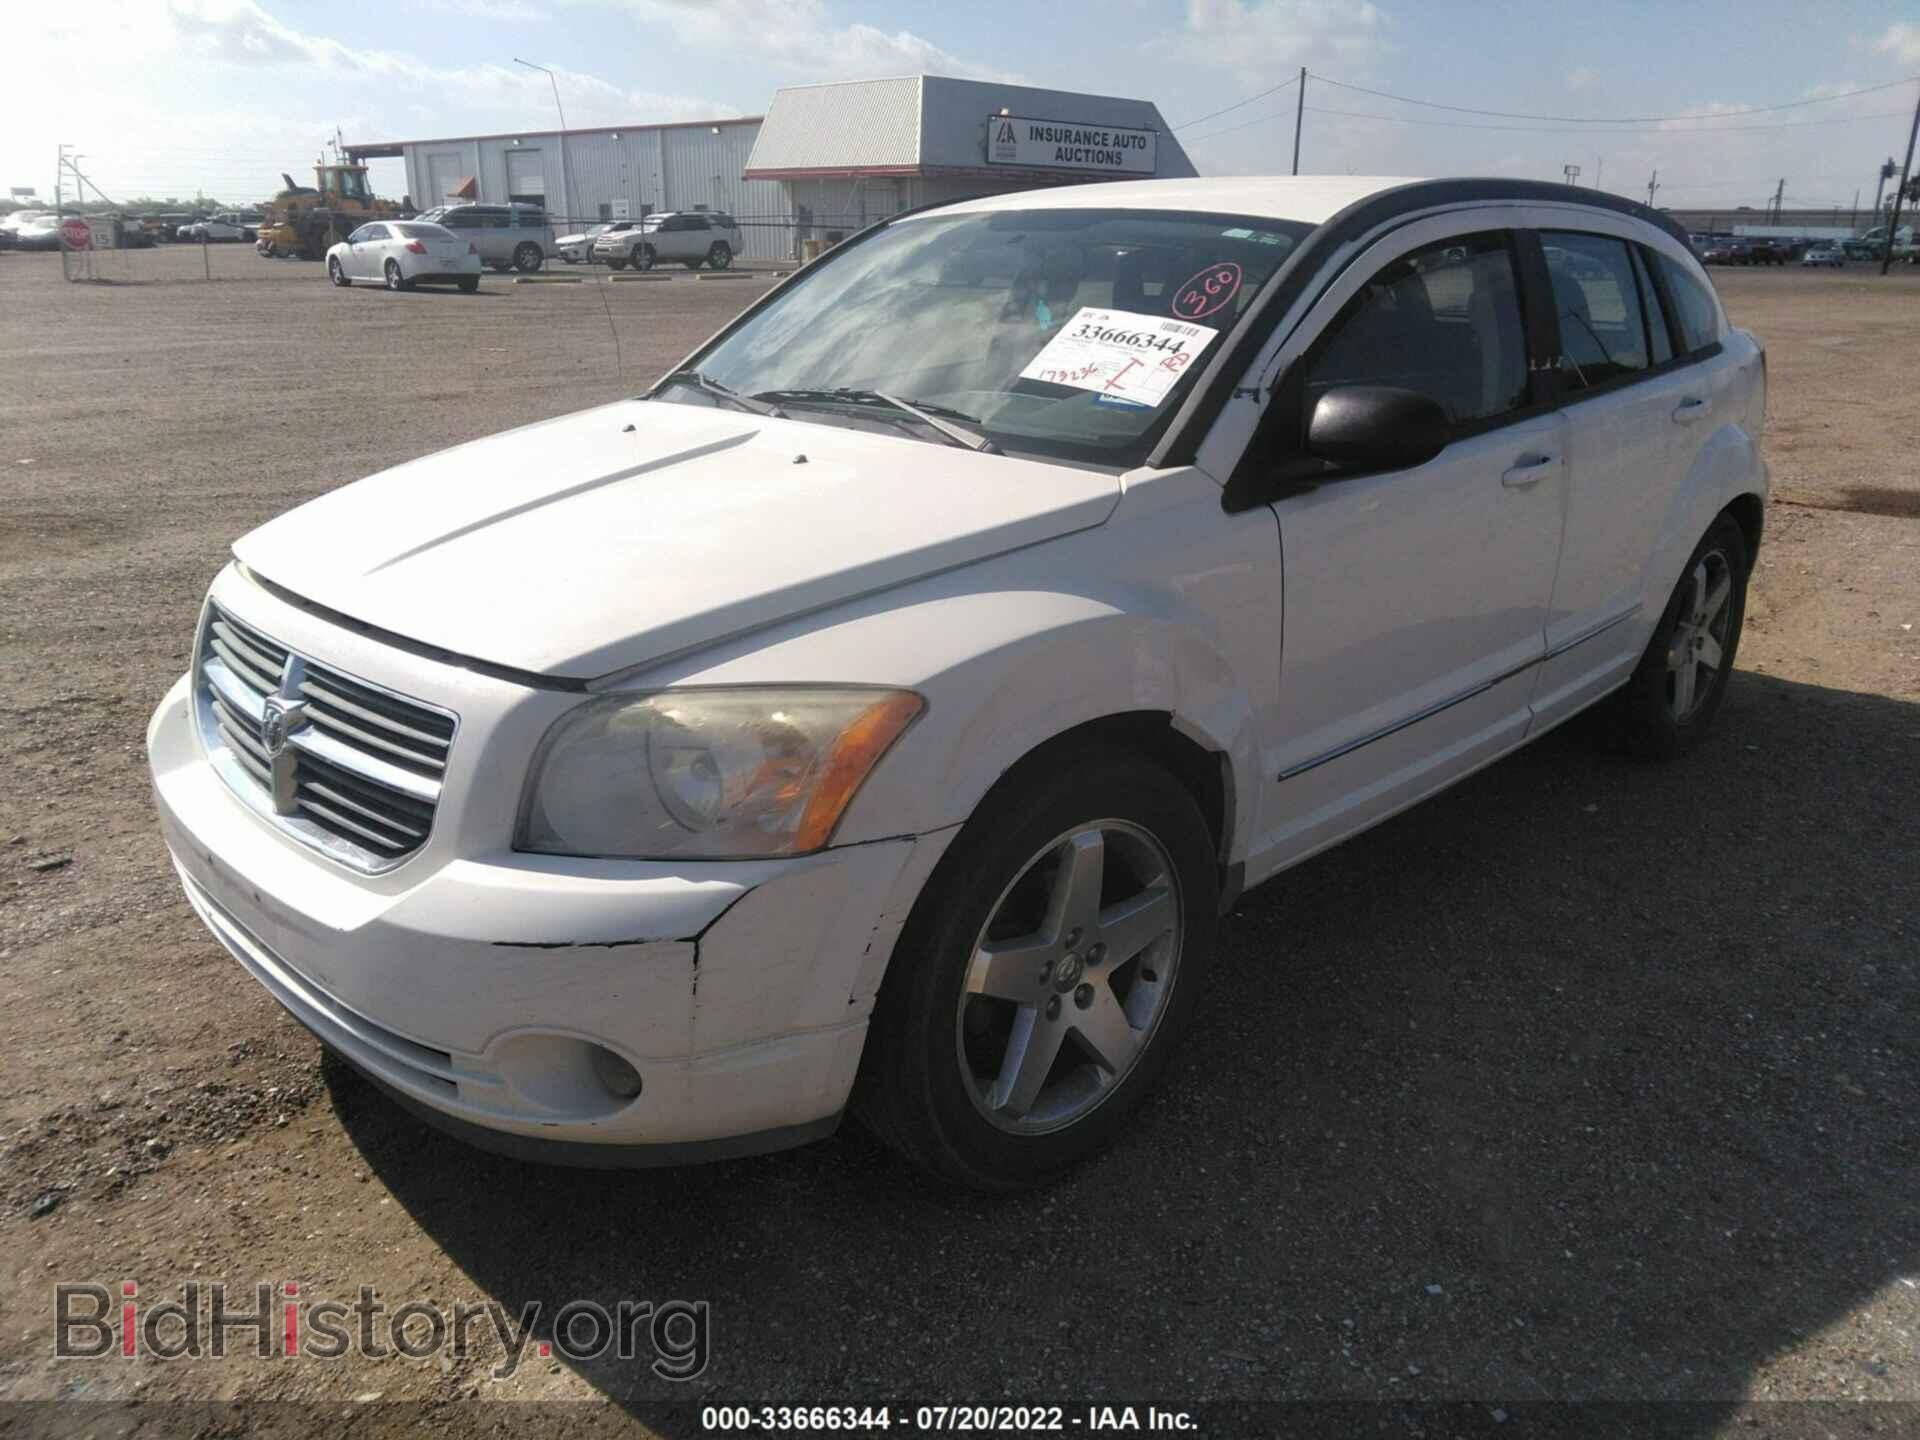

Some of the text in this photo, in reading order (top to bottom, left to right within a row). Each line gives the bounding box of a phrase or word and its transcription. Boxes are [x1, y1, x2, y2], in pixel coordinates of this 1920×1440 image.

[1029, 126, 1146, 150] INSURANCE AUTO
[1055, 147, 1123, 165] AUCTIONS
[1183, 271, 1233, 314] 360
[1072, 324, 1186, 354] 33666344
